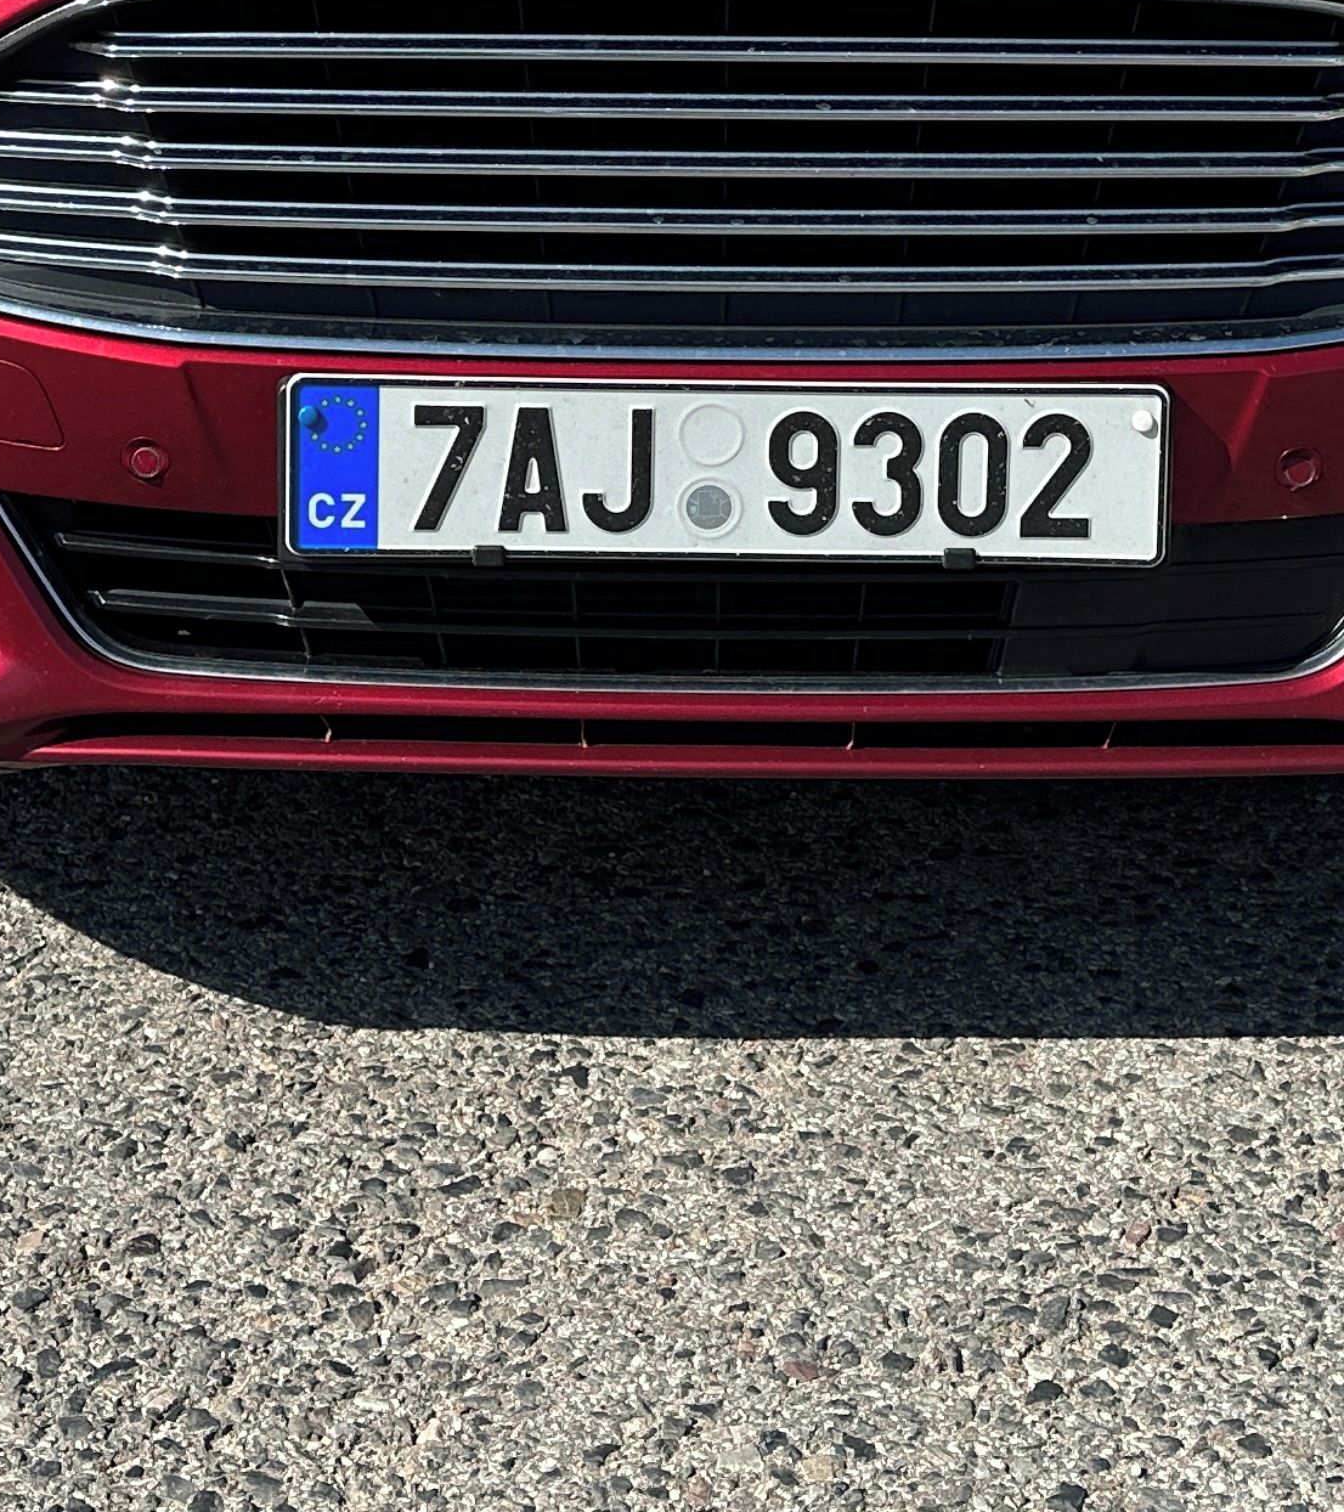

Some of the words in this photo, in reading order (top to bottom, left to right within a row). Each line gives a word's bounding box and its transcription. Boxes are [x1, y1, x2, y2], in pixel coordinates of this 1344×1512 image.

[307, 491, 366, 529] CZ
[412, 404, 654, 532] 7AJ
[766, 410, 1093, 540] 9302
